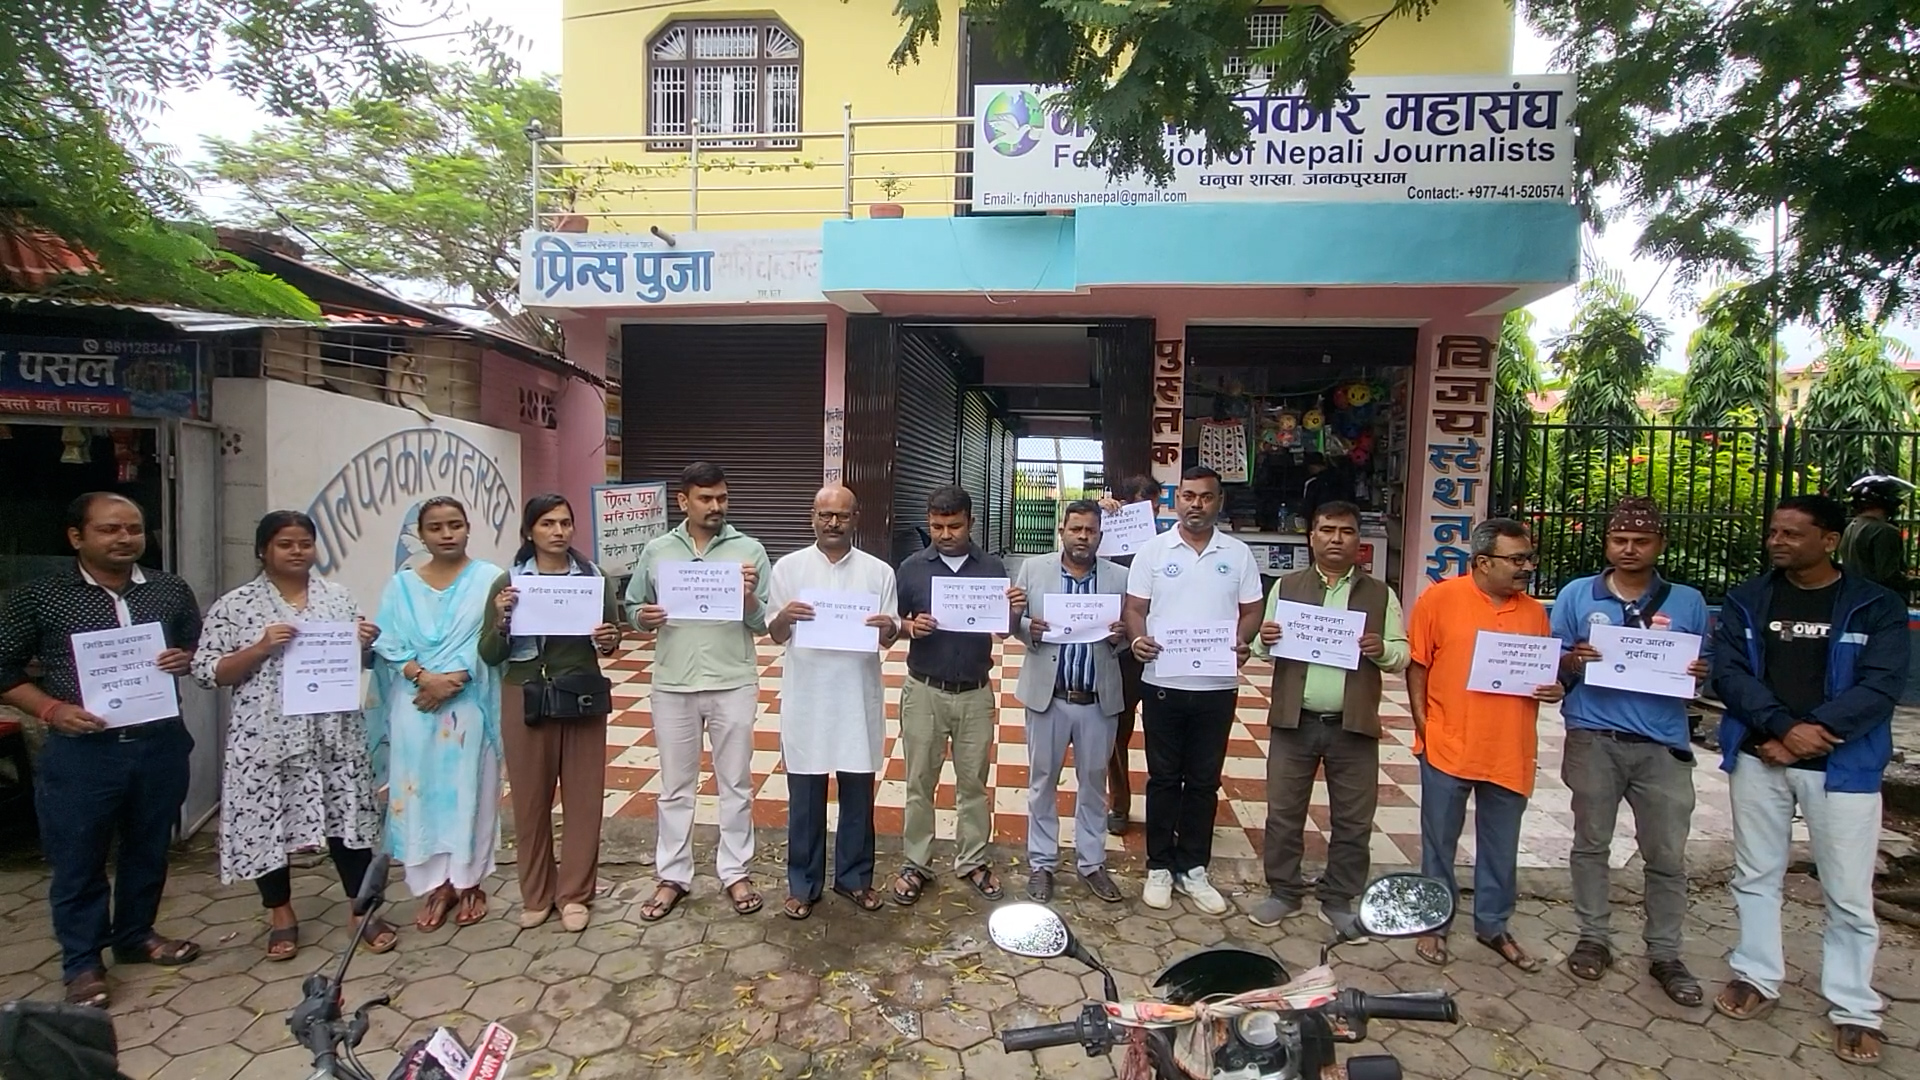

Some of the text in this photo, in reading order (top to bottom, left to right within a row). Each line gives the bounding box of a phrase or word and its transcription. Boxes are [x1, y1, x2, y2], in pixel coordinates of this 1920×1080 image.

[1386, 81, 1563, 137] महासंघ
[1226, 140, 1256, 165] of
[1266, 139, 1363, 170] Nepali
[1374, 137, 1556, 164] Journalists
[1199, 174, 1244, 189] धनुषा
[1302, 172, 1408, 188] जनकपुरधाम
[1407, 184, 1564, 200] Contact:- +977-41-520574
[984, 189, 1187, 208] Email:- fnjdhanushanepal@gmail.com
[532, 235, 628, 299] प्रिन्स
[633, 250, 715, 303] पुजा
[18, 350, 119, 387] पसल
[1434, 335, 1496, 437] विजय
[1151, 338, 1183, 466] पुस्तक
[305, 428, 516, 576] पाल पत्रकार महासंघ
[1620, 636, 1675, 648] राज्य आतंक
[89, 666, 118, 677] राज्य
